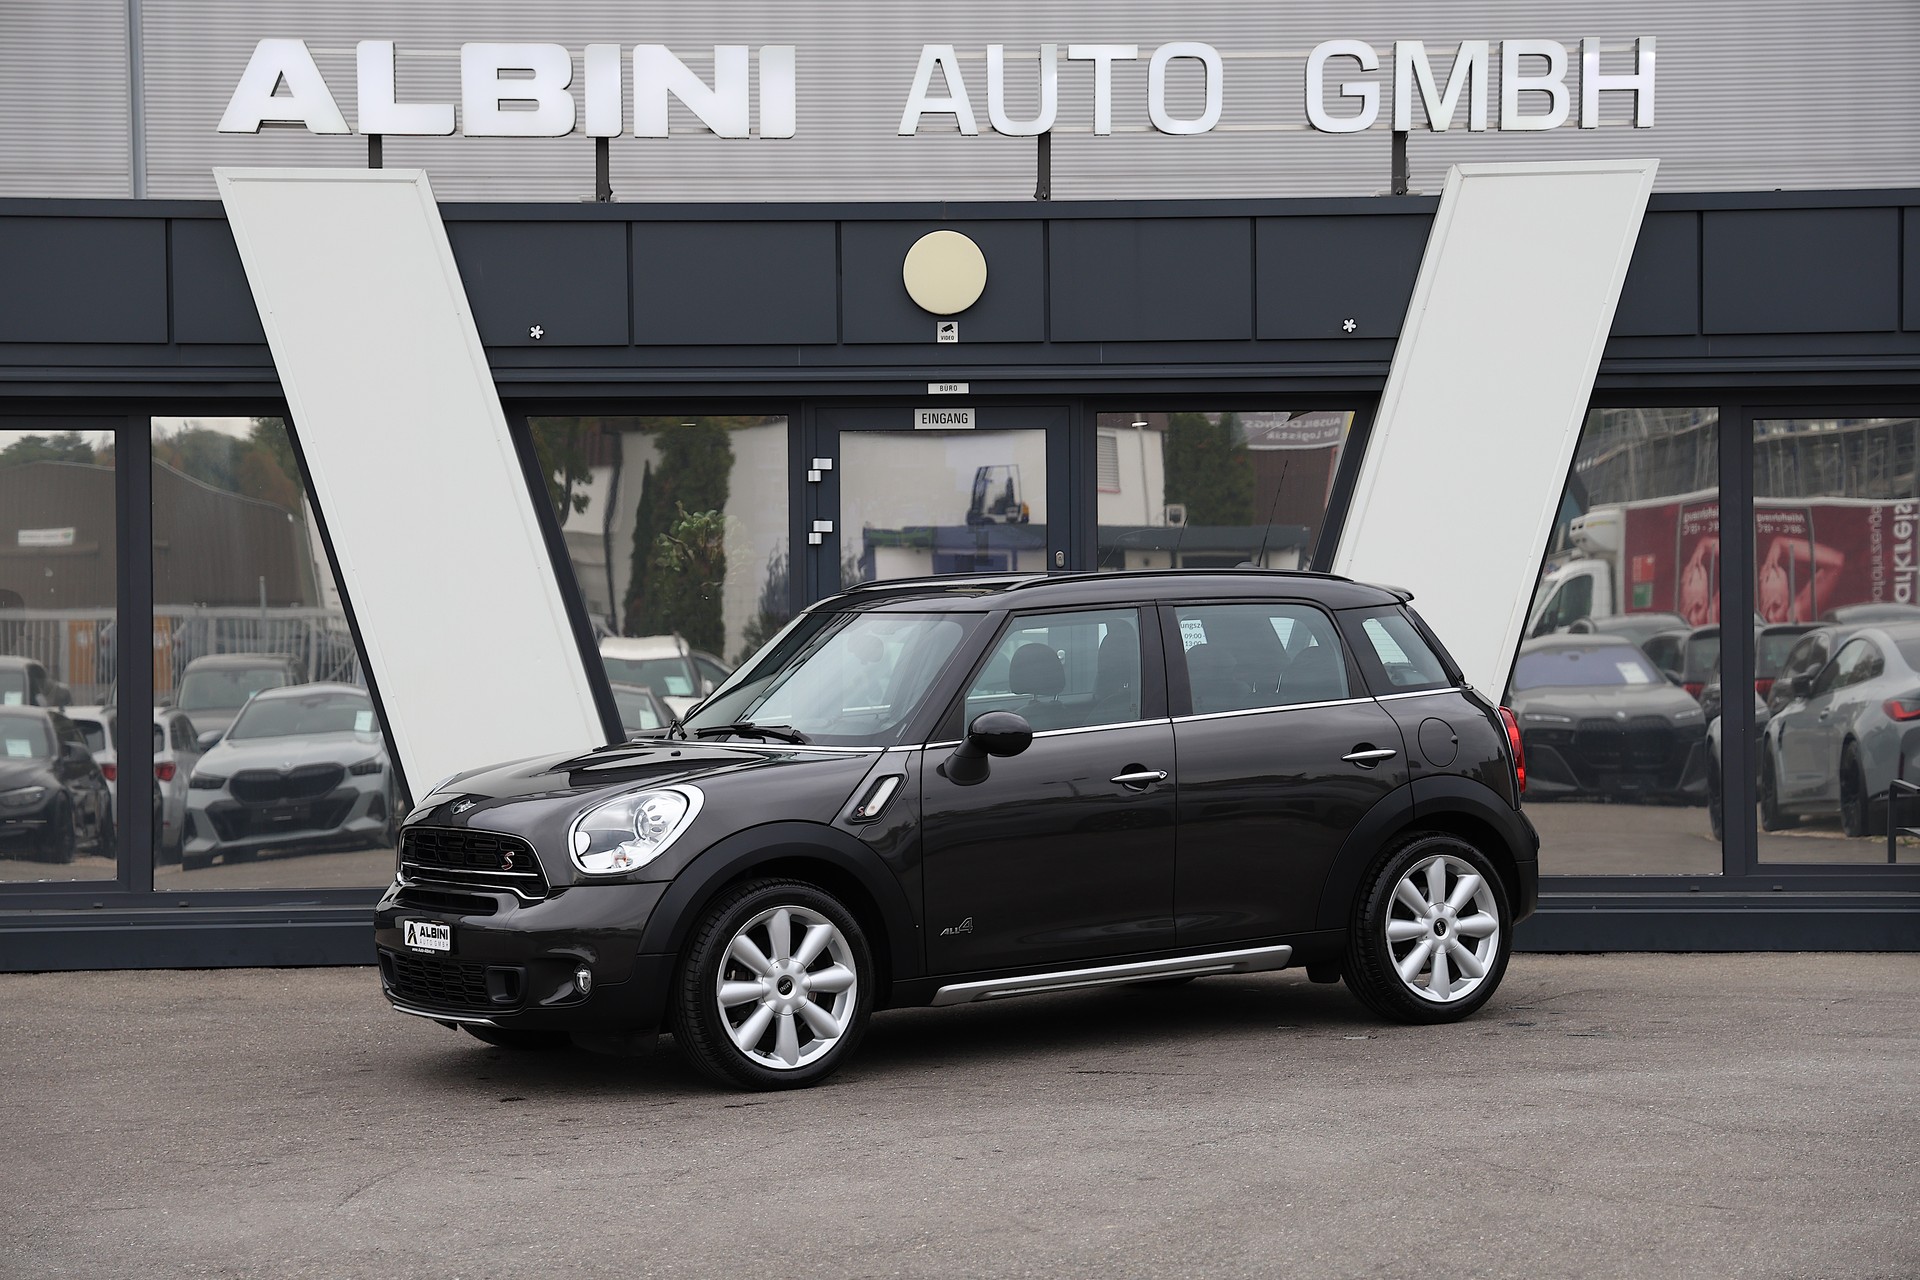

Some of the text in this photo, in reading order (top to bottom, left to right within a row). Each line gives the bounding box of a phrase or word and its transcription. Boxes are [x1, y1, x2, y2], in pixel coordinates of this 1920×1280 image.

[216, 35, 1657, 138] ALBINI AUTO GMBH
[939, 384, 958, 392] BÜRO
[921, 412, 968, 424] EINGANG
[420, 925, 448, 940] ALBINI
